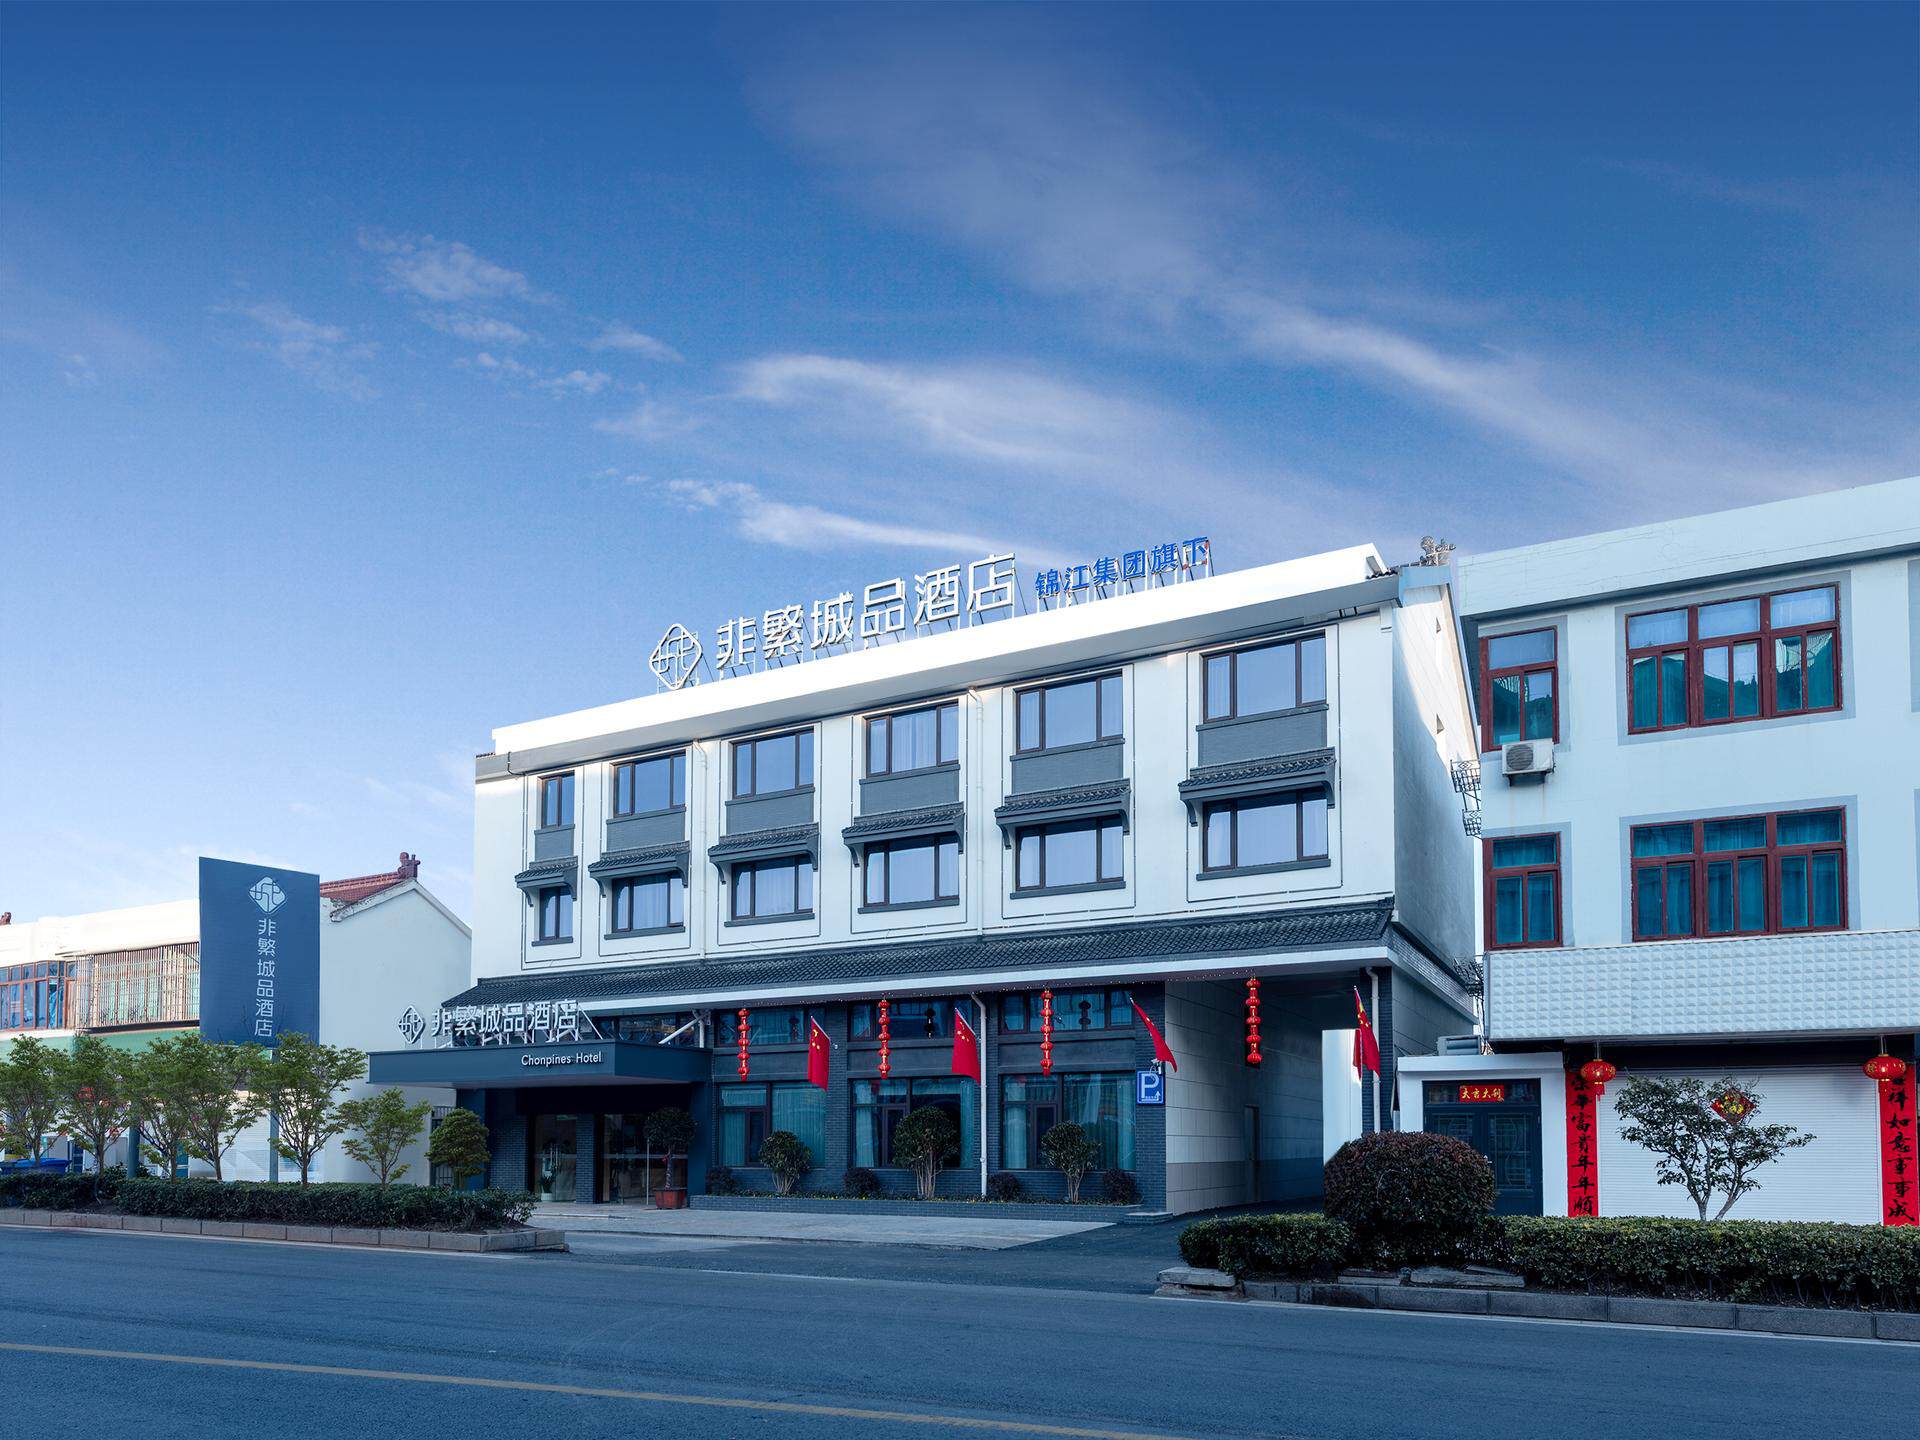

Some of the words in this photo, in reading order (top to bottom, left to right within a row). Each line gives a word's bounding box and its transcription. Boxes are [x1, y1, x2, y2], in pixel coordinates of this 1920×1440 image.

[1035, 536, 1208, 597] 锦江集团旗下
[716, 553, 1015, 669] 非繁城品酒店
[254, 918, 277, 1037] 非繁城品酒店
[431, 999, 577, 1037] 非繁城品酒店
[521, 1054, 571, 1068] Chonpines
[575, 1050, 602, 1063] Hotel
